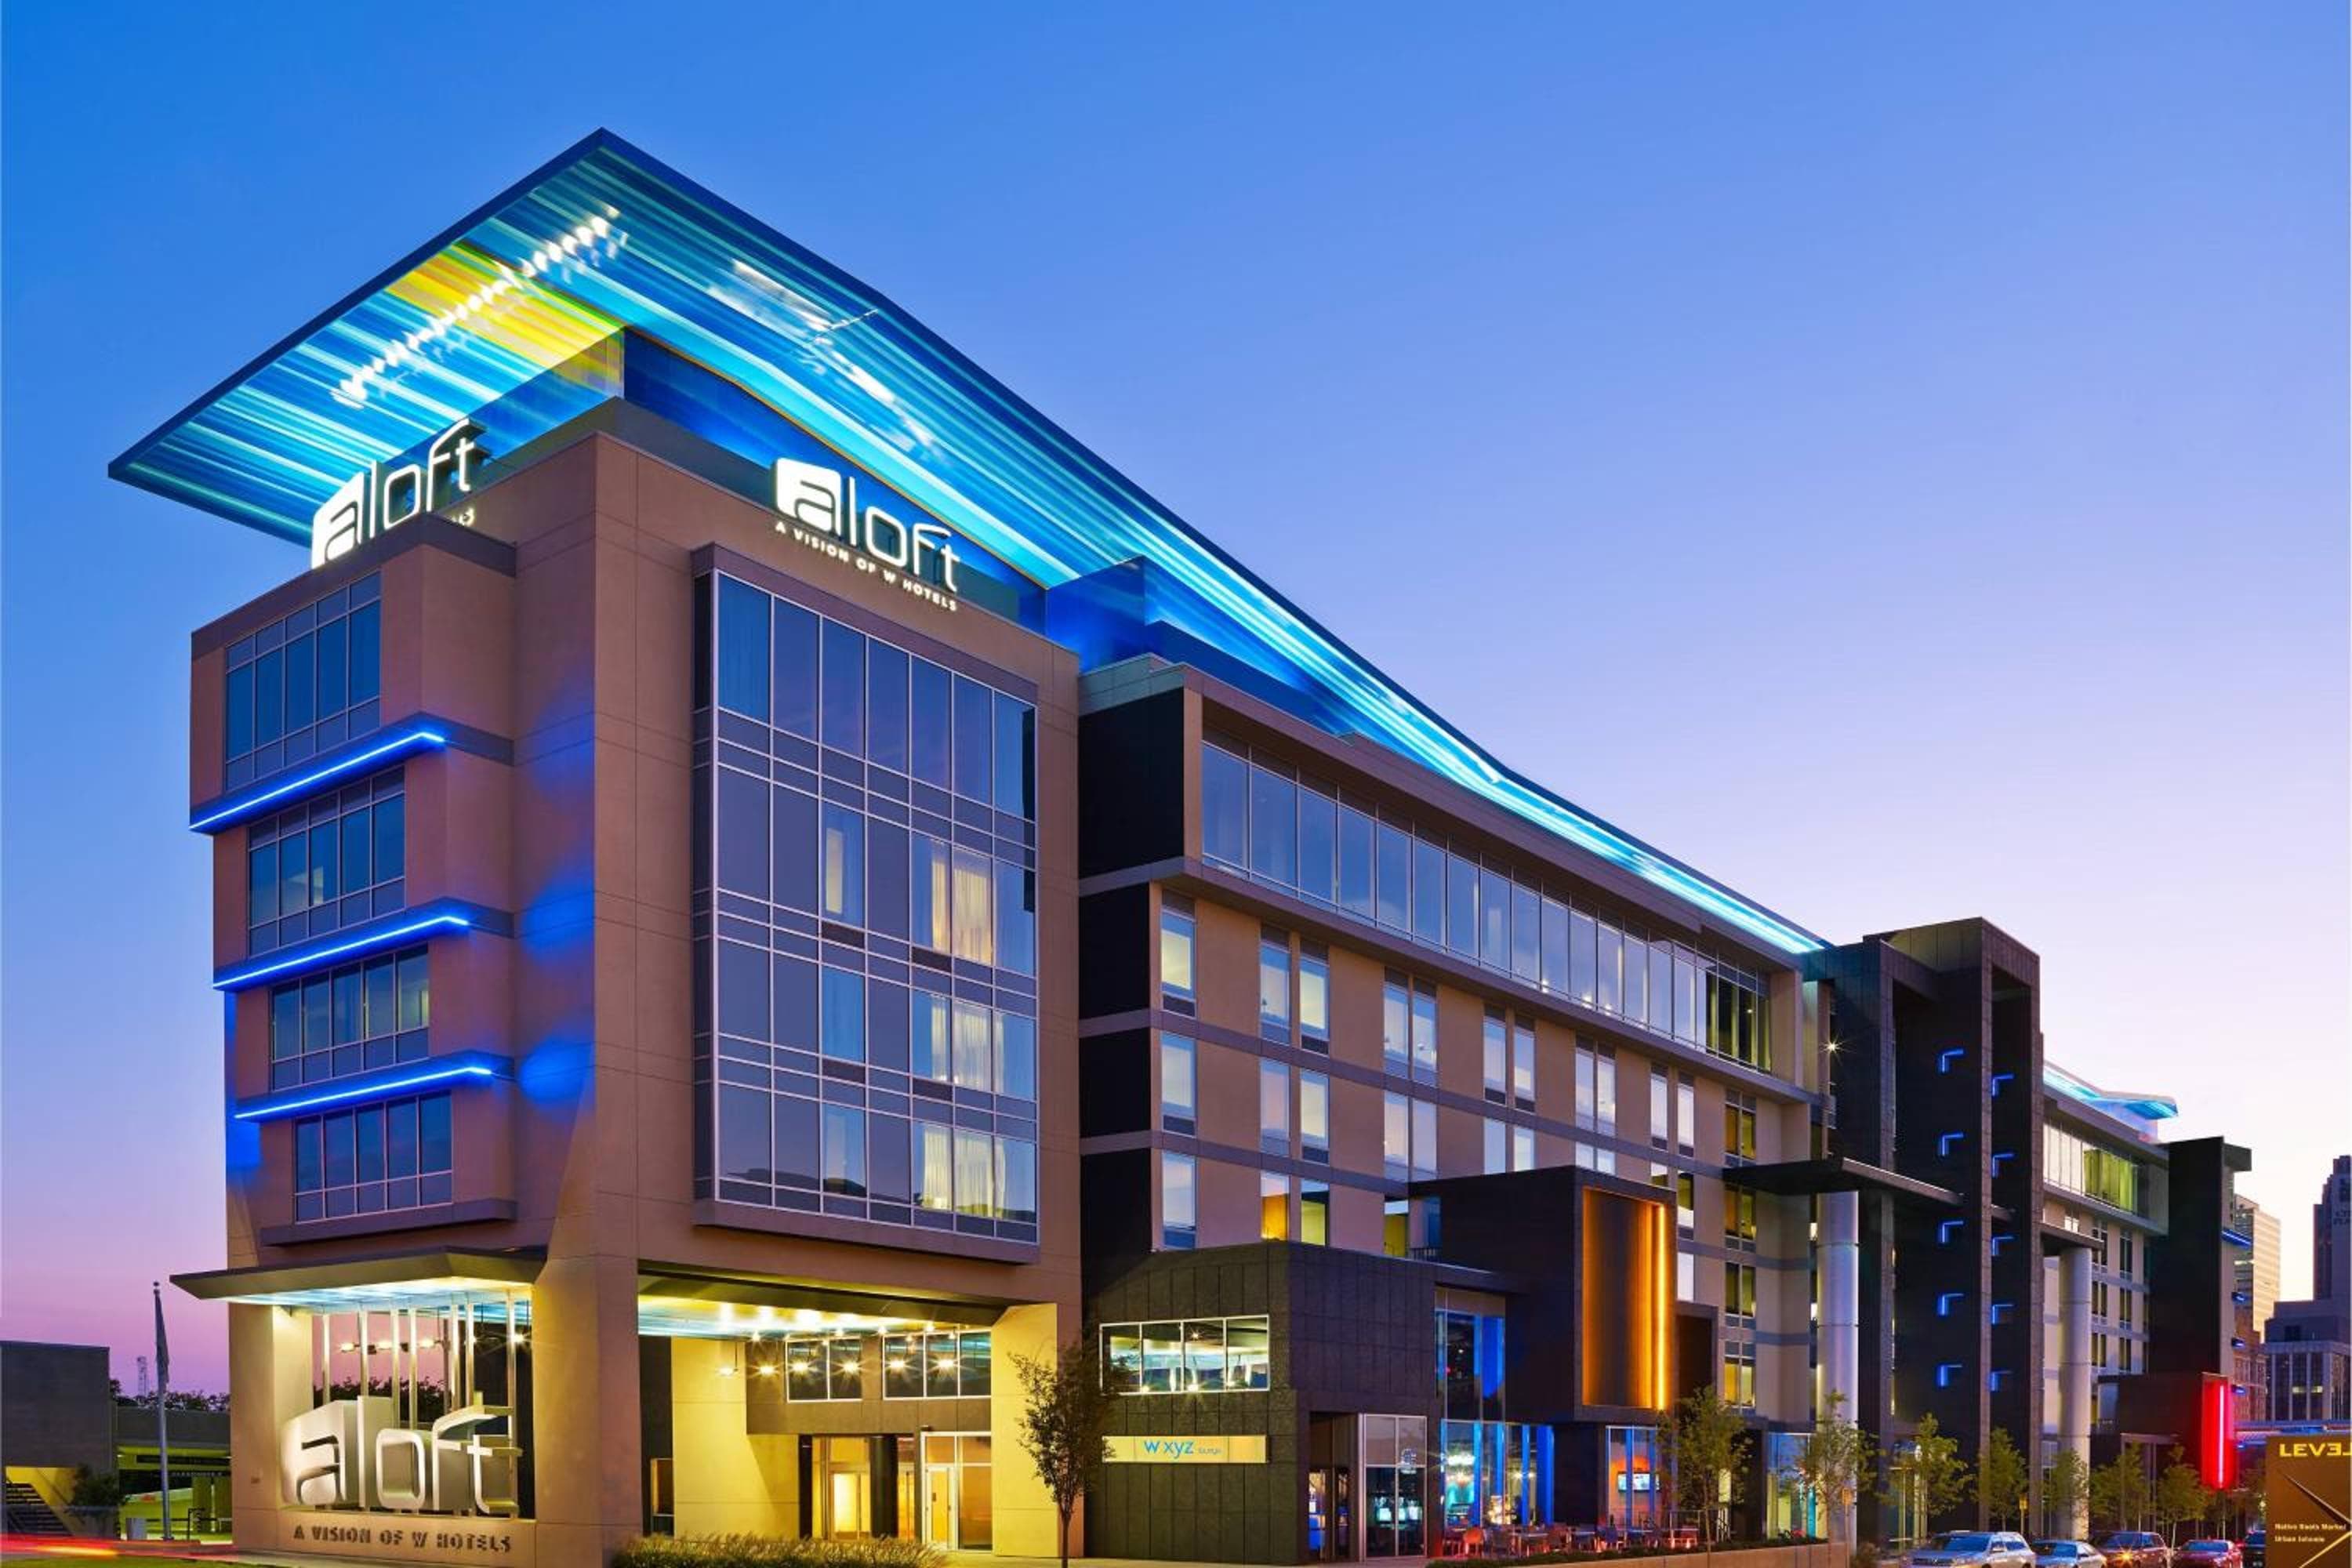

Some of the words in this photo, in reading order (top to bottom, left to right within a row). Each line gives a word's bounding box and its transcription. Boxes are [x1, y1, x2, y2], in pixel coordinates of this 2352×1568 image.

[311, 417, 477, 569] aloft
[776, 457, 960, 593] aloft
[775, 521, 786, 534] A
[793, 528, 849, 562] VISION
[856, 557, 877, 573] OF
[883, 569, 896, 583] W
[902, 579, 957, 612] HOTELS
[280, 1395, 498, 1514] aloft
[293, 1523, 305, 1540] A
[311, 1526, 371, 1544] VISION
[379, 1530, 403, 1545] OF
[412, 1531, 428, 1548] W
[437, 1533, 511, 1552] HOTELS
